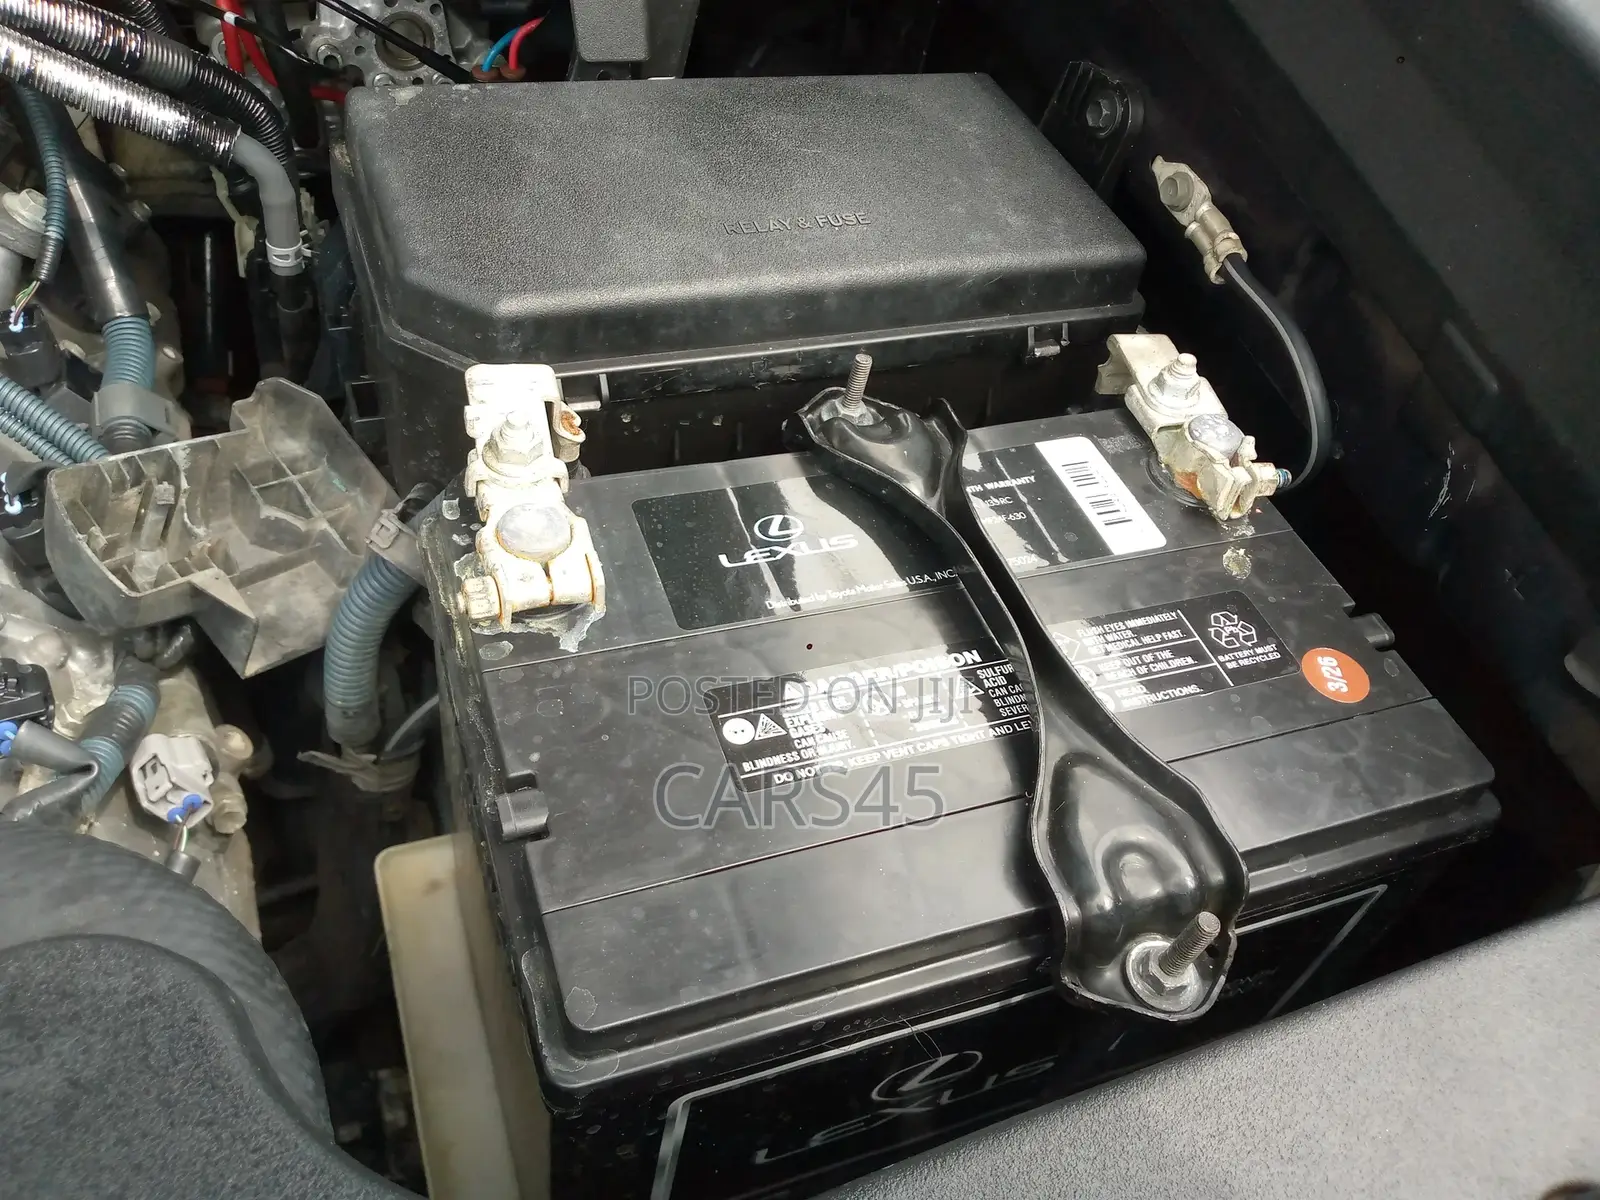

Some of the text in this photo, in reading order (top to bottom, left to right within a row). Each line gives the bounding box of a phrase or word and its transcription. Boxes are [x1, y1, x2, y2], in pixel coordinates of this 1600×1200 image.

[723, 212, 871, 235] RELAY & FUSE
[984, 475, 1036, 490] WARRANTY
[718, 534, 858, 567] LEXUS
[765, 594, 815, 610] Distributed
[828, 588, 856, 600] Toyota
[856, 583, 883, 595] Motor
[1076, 611, 1178, 638] FLUSH EYES IMMEDIATELY
[1105, 628, 1137, 641] WATER.
[1105, 638, 1142, 652] MEDICAL
[1141, 633, 1162, 645] HELP
[1162, 629, 1187, 641] FAST.
[1098, 649, 1174, 673] KEEP OUT OF THE
[1217, 644, 1278, 662] BATTERY MUST
[1226, 652, 1281, 670] BE RECYCLED
[1103, 656, 1198, 682] REACH OF CHILDREN.
[1317, 656, 1349, 693] 3/26
[983, 675, 1007, 689] ACID
[988, 686, 1008, 698] CAN
[789, 722, 826, 739] GASES
[773, 771, 794, 785] DO
[796, 765, 821, 780] NOT
[848, 752, 880, 767] KEEP
[882, 743, 914, 760] VENT
[916, 737, 949, 752] CAPS
[953, 730, 986, 744] TIGHT
[989, 724, 1013, 738] AND
[794, 736, 815, 750] CAN
[742, 751, 801, 773] BLINDNESS
[800, 747, 817, 761] OR
[755, 1055, 1058, 1164] LEXUS
